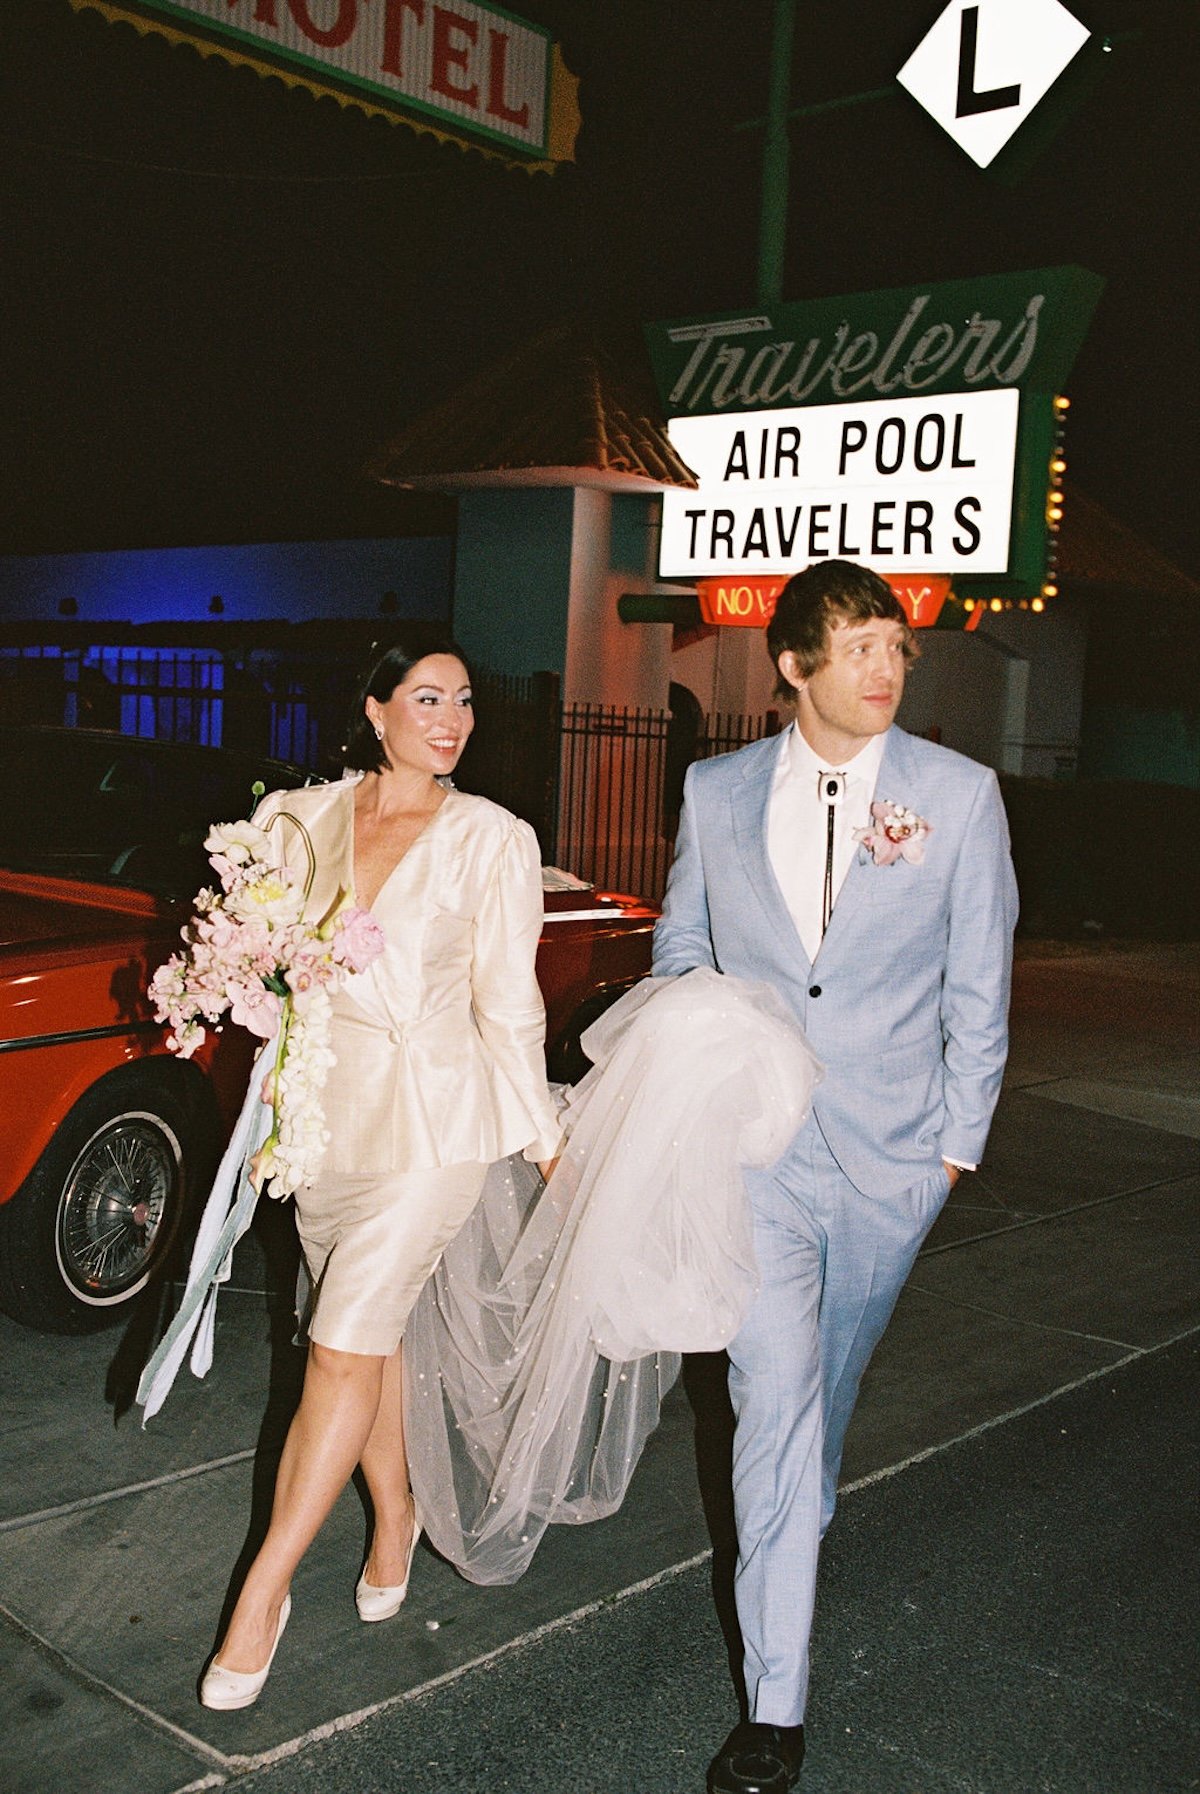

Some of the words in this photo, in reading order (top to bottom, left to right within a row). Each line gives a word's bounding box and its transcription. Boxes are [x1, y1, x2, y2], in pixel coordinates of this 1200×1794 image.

[226, 0, 529, 128] OTEL
[955, 6, 1021, 118] L
[668, 295, 1044, 409] Travelers
[724, 427, 801, 481] AIR
[839, 414, 976, 475] POOL
[685, 497, 982, 559] TRAVELERS
